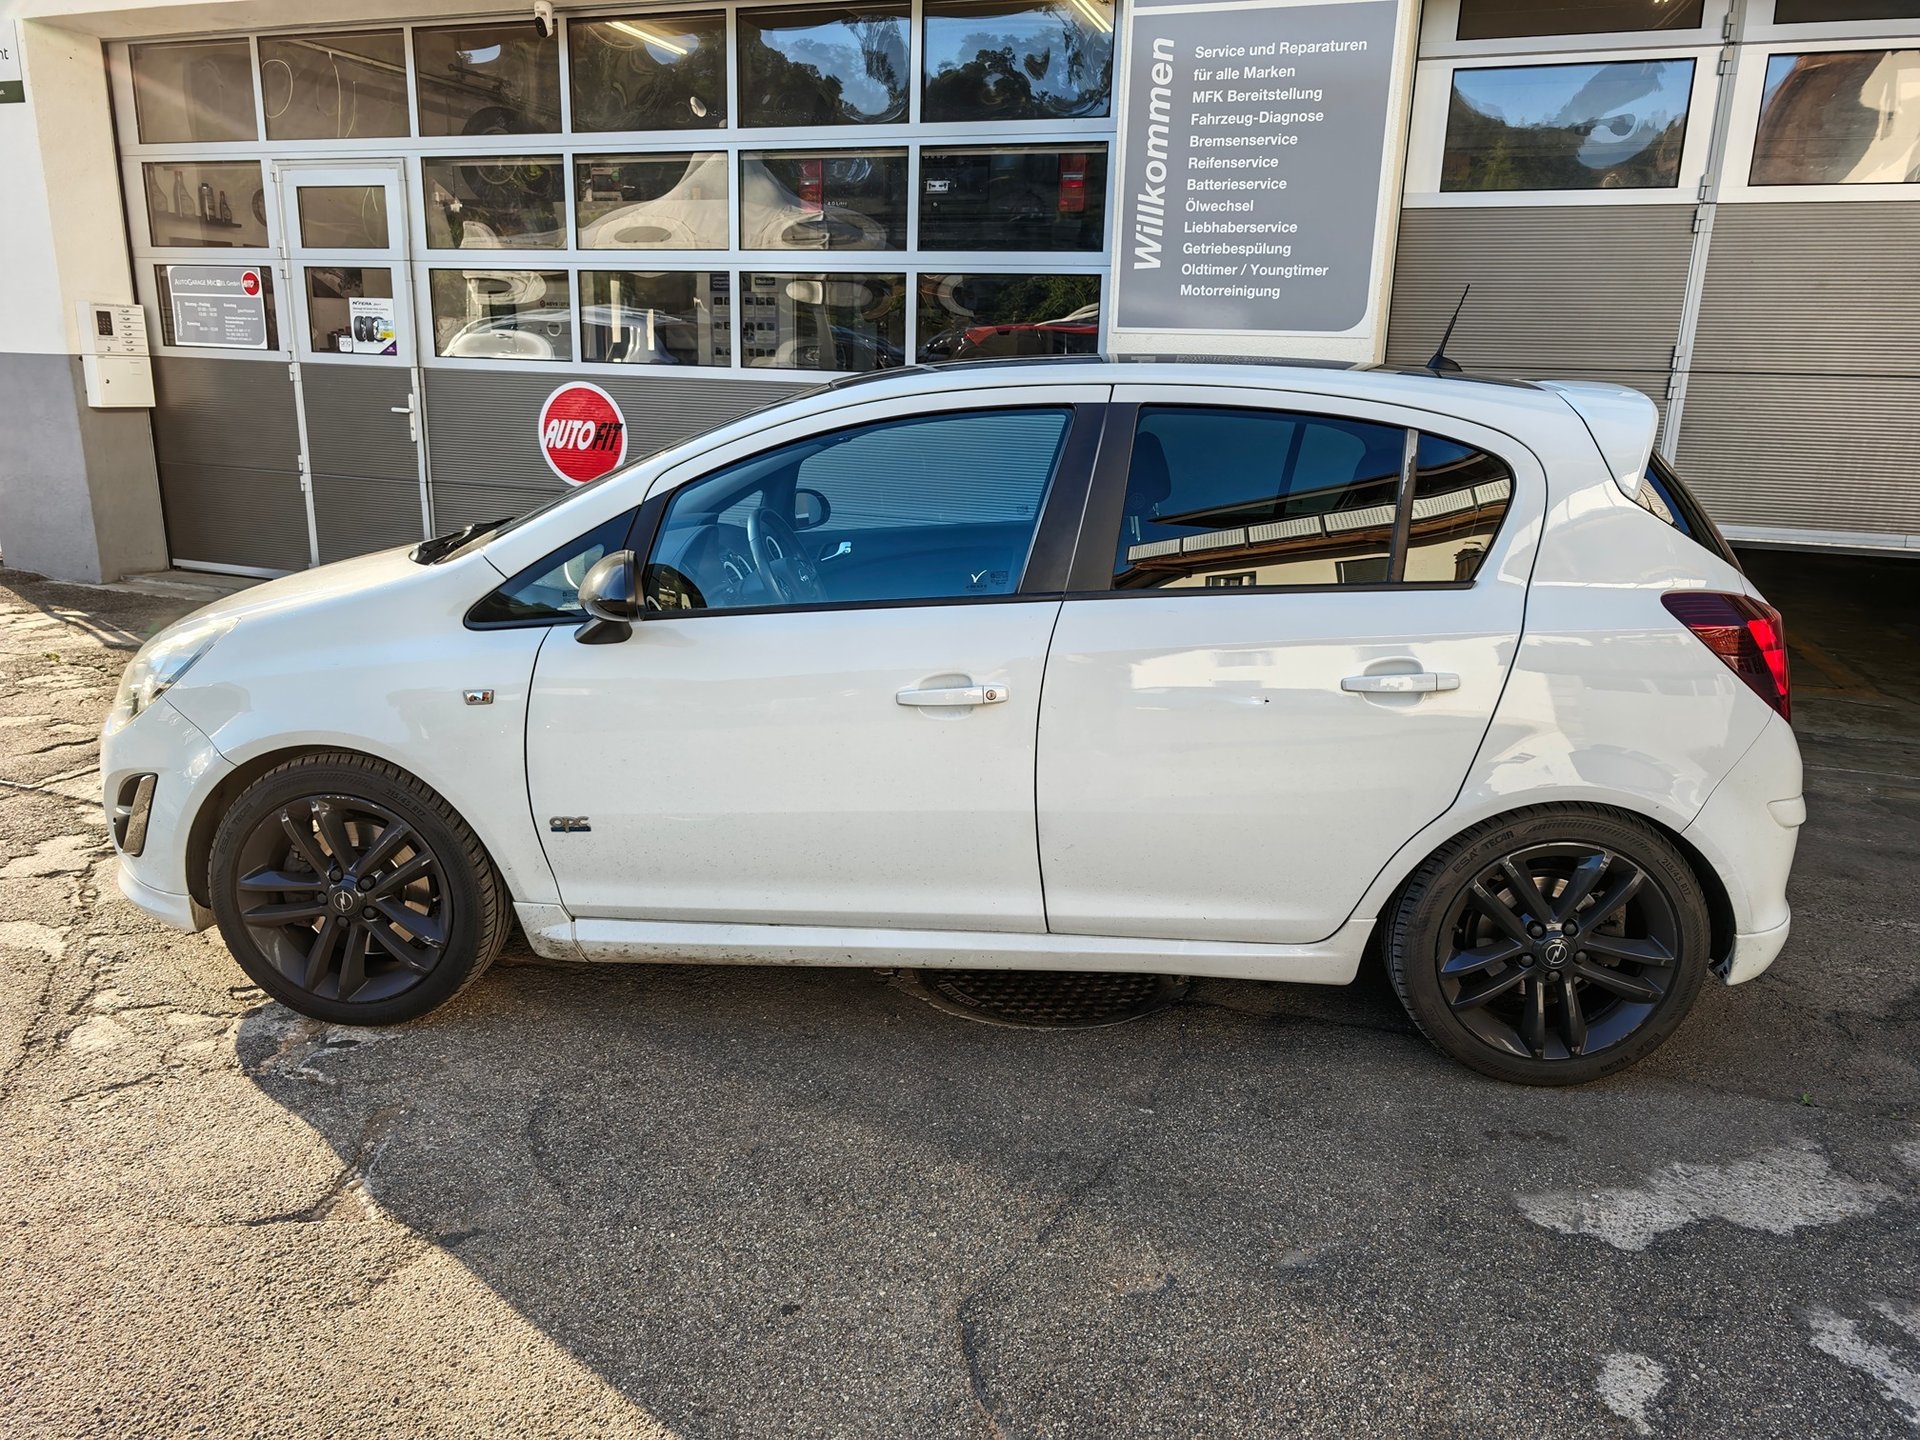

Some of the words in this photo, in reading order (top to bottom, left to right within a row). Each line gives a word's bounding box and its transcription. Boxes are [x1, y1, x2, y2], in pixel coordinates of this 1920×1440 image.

[1195, 44, 1245, 59] Service
[1249, 42, 1276, 56] und
[1279, 39, 1368, 56] Reparaturen
[1193, 68, 1213, 81] für
[1216, 67, 1240, 80] alle
[1243, 65, 1296, 79] Marken
[1192, 90, 1224, 103] MFK
[1227, 87, 1323, 102] Bereitstellung
[1191, 111, 1324, 127] Fahrzeug-Diagnose
[1189, 133, 1298, 147] Bremsenservice
[1133, 37, 1175, 270] Willkommen
[1188, 156, 1279, 169] Reifenservice
[1187, 178, 1287, 191] Batterieservice
[1185, 197, 1254, 212] Ölwechsel
[1184, 221, 1298, 233] Liebhaberservice
[1182, 242, 1292, 257] Getriebespülung
[1181, 263, 1238, 275] Oldtimer
[1240, 264, 1248, 275] /
[1250, 264, 1329, 279] Youngtimer
[1180, 284, 1281, 300] Motorreinigung
